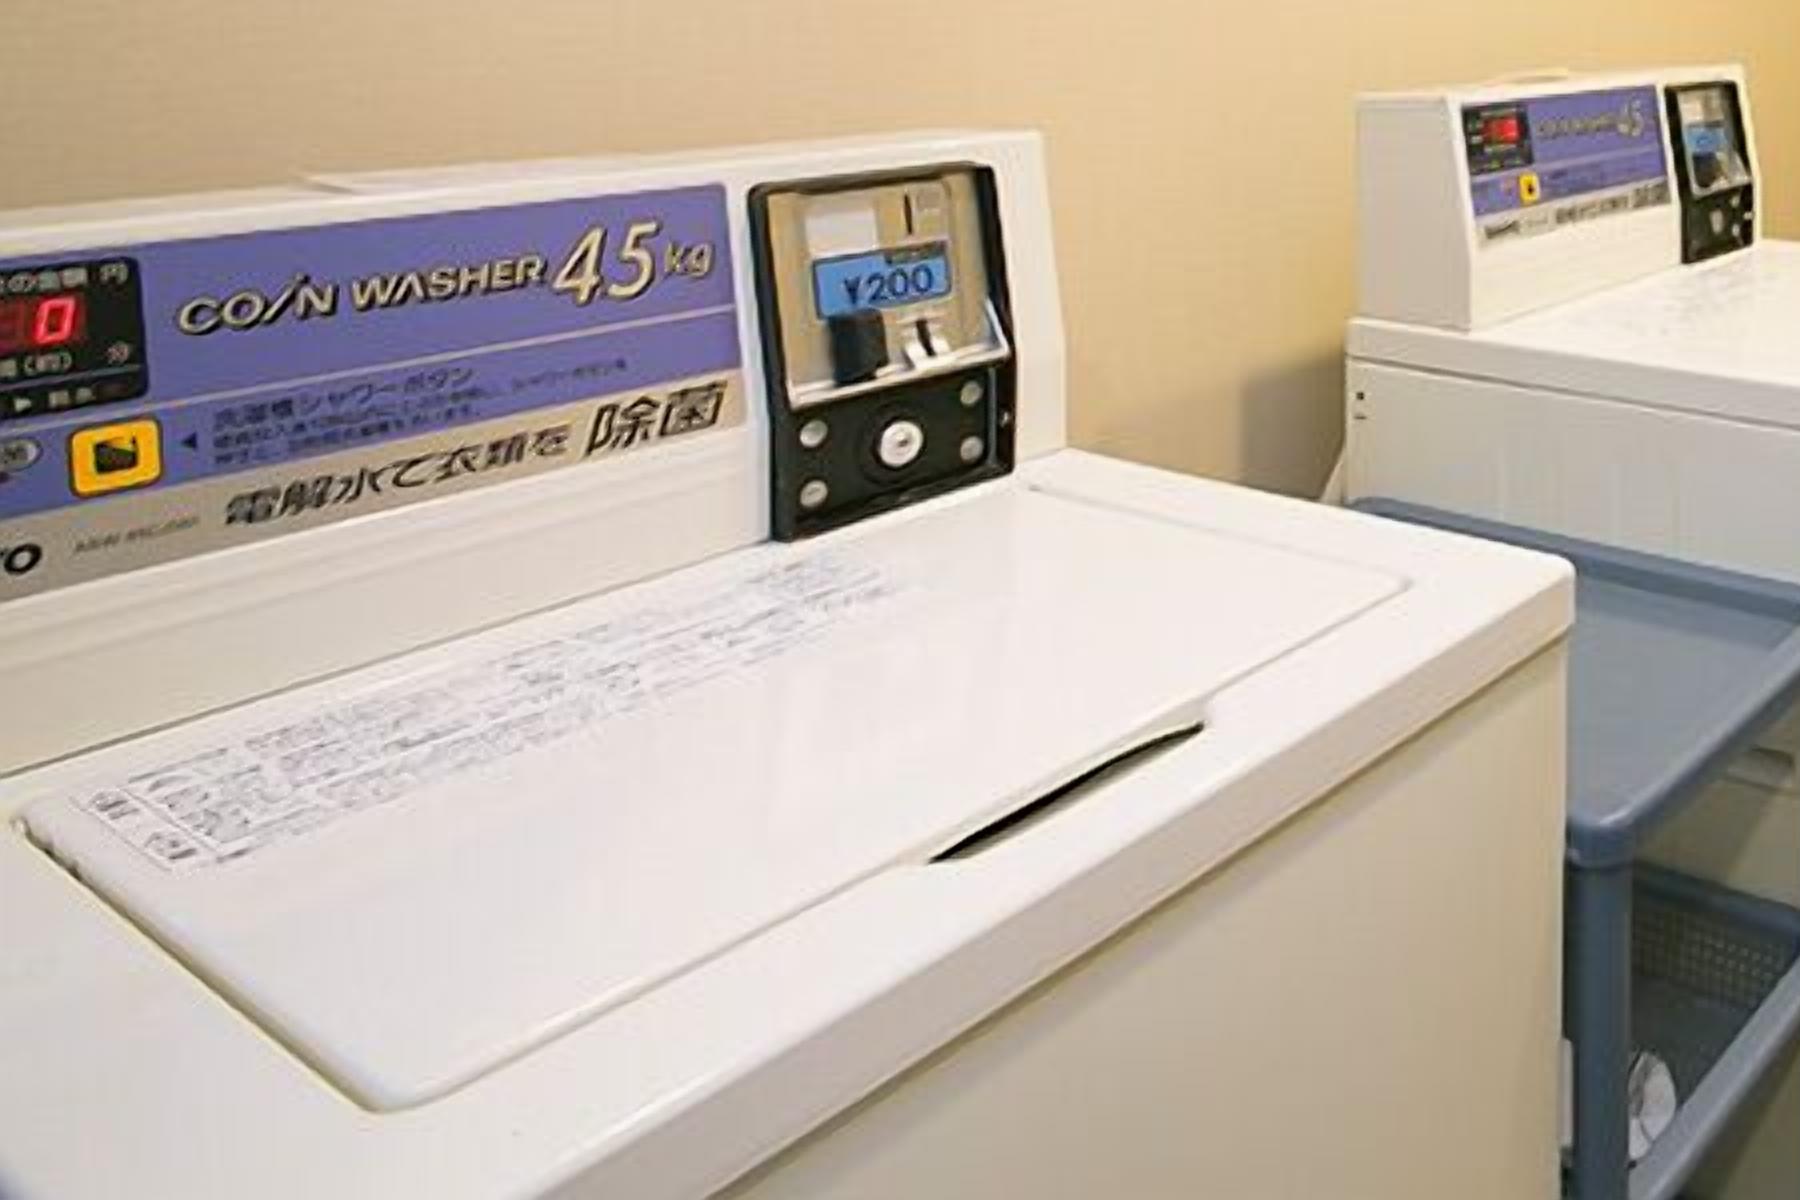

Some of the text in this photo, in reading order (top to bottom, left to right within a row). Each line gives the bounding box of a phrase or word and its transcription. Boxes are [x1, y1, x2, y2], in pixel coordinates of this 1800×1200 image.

[178, 274, 339, 336] COIN
[351, 255, 547, 312] WASHER
[843, 263, 933, 306] ¥200
[33, 297, 76, 346] 0
